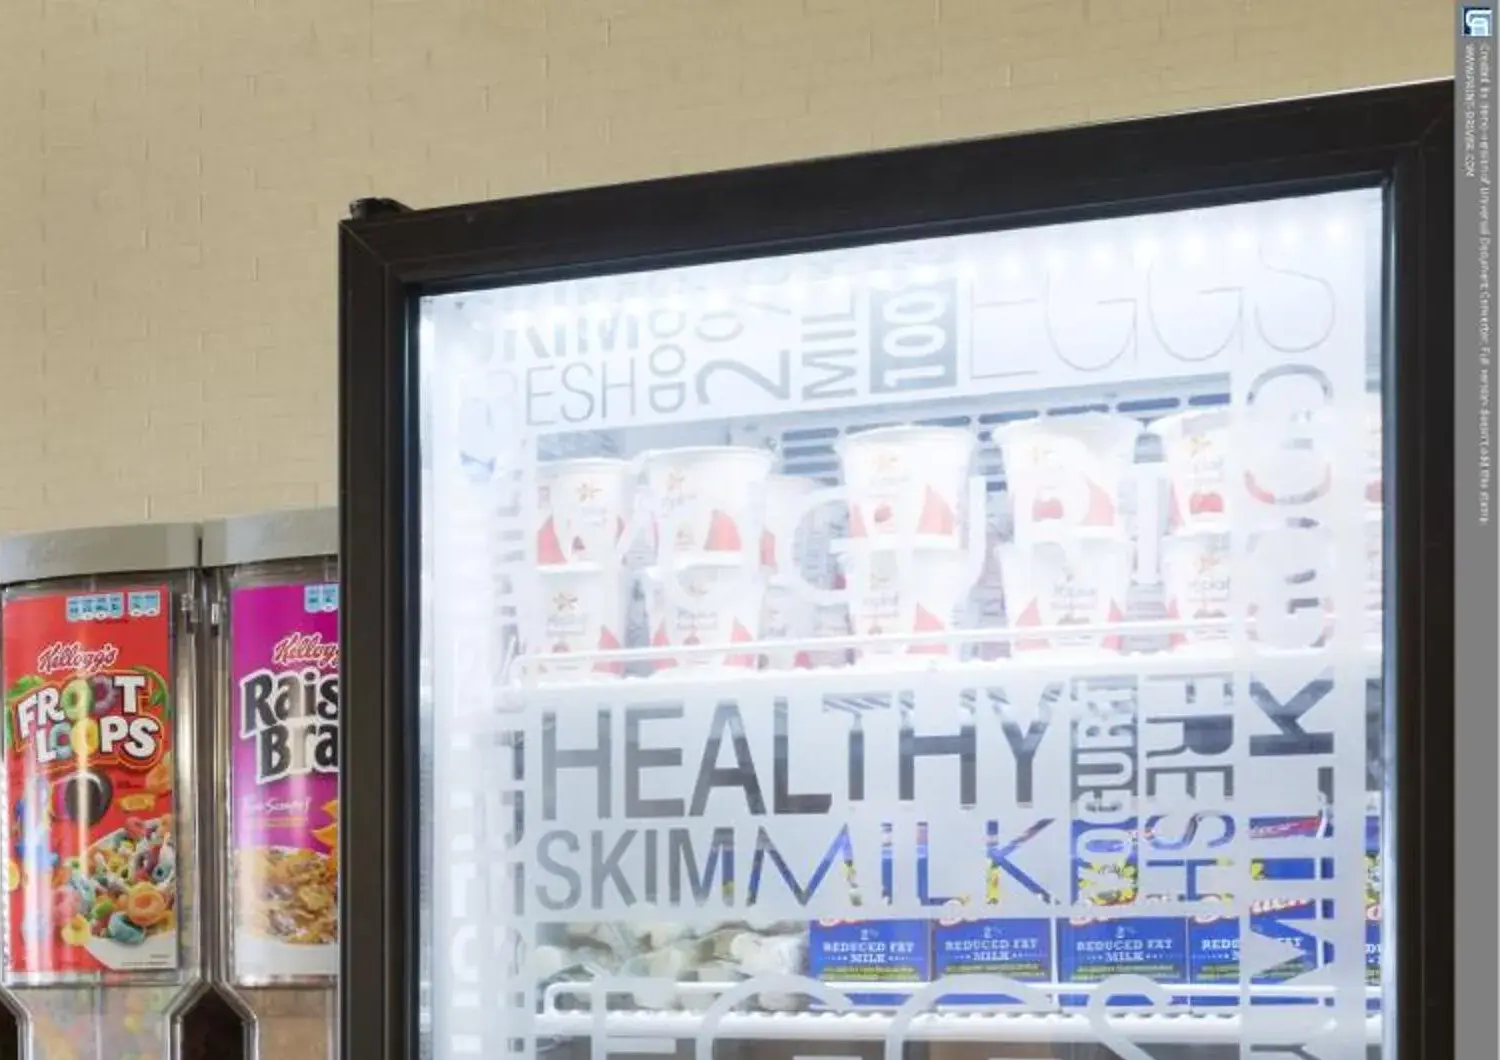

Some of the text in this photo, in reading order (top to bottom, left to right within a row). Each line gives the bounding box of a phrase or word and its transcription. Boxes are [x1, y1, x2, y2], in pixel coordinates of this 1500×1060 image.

[37, 641, 119, 674] Kellogg's
[17, 674, 145, 739] FROOT
[35, 717, 160, 764] LOOPS
[542, 685, 1065, 820] HEALTHY
[1146, 670, 1236, 903] FRESH
[536, 826, 735, 910] SKIM
[823, 941, 915, 953] REDUCED FAT
[945, 938, 1039, 951] REDUCED FAT
[1076, 938, 1173, 951] REDUCED FAT
